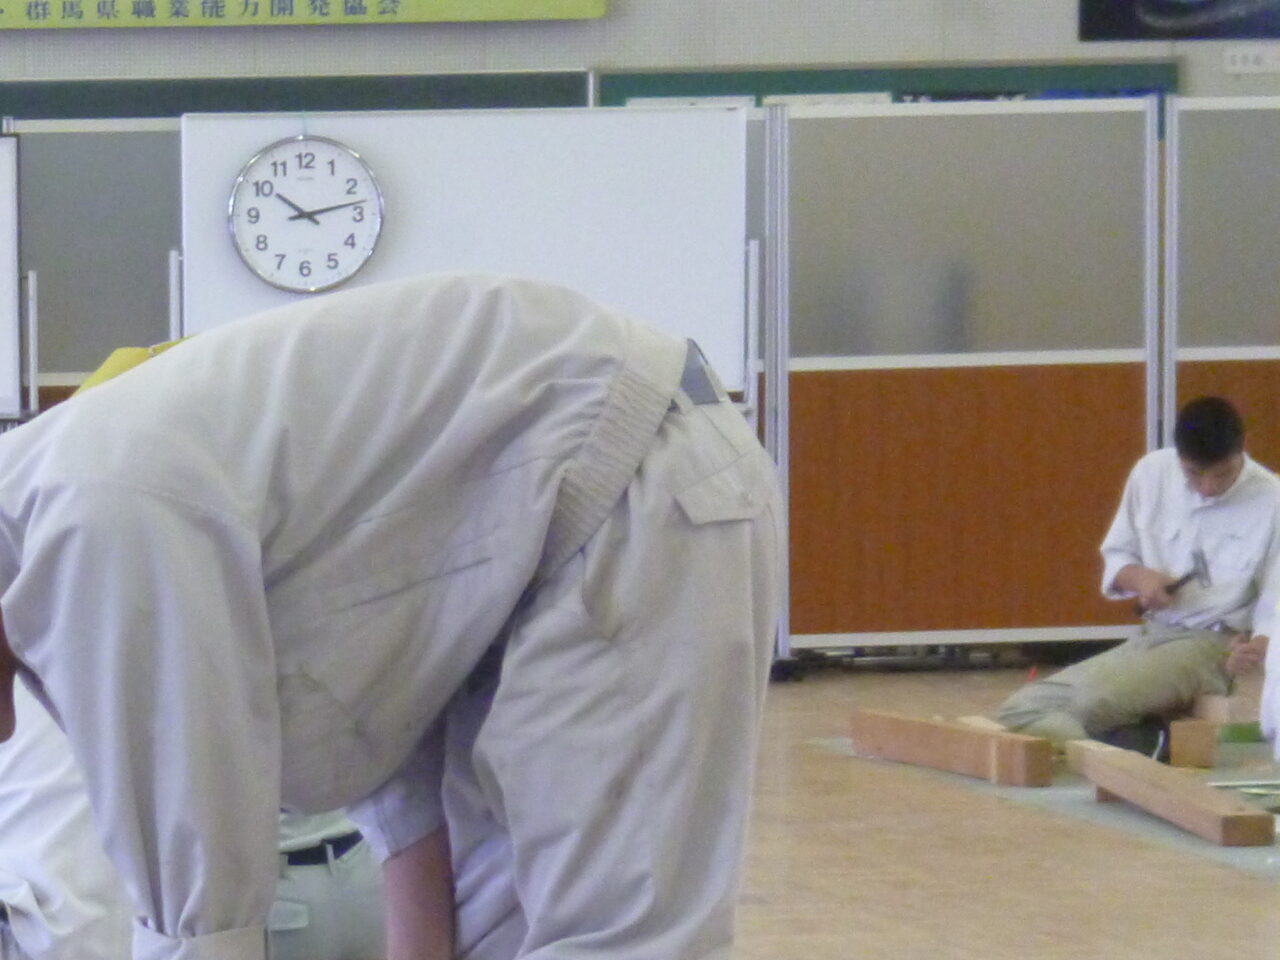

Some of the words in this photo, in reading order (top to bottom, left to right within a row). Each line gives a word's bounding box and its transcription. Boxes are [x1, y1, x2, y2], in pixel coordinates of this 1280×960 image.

[295, 152, 315, 169] 12
[328, 159, 336, 176] 1
[271, 161, 288, 177] 11
[253, 181, 274, 197] 10
[346, 178, 358, 195] 2
[248, 208, 260, 224] 9
[353, 207, 364, 222] 3
[256, 235, 268, 251] 8
[344, 233, 356, 248] 4
[275, 255, 286, 270] 7
[299, 261, 312, 277] 6
[327, 253, 339, 269] 5
